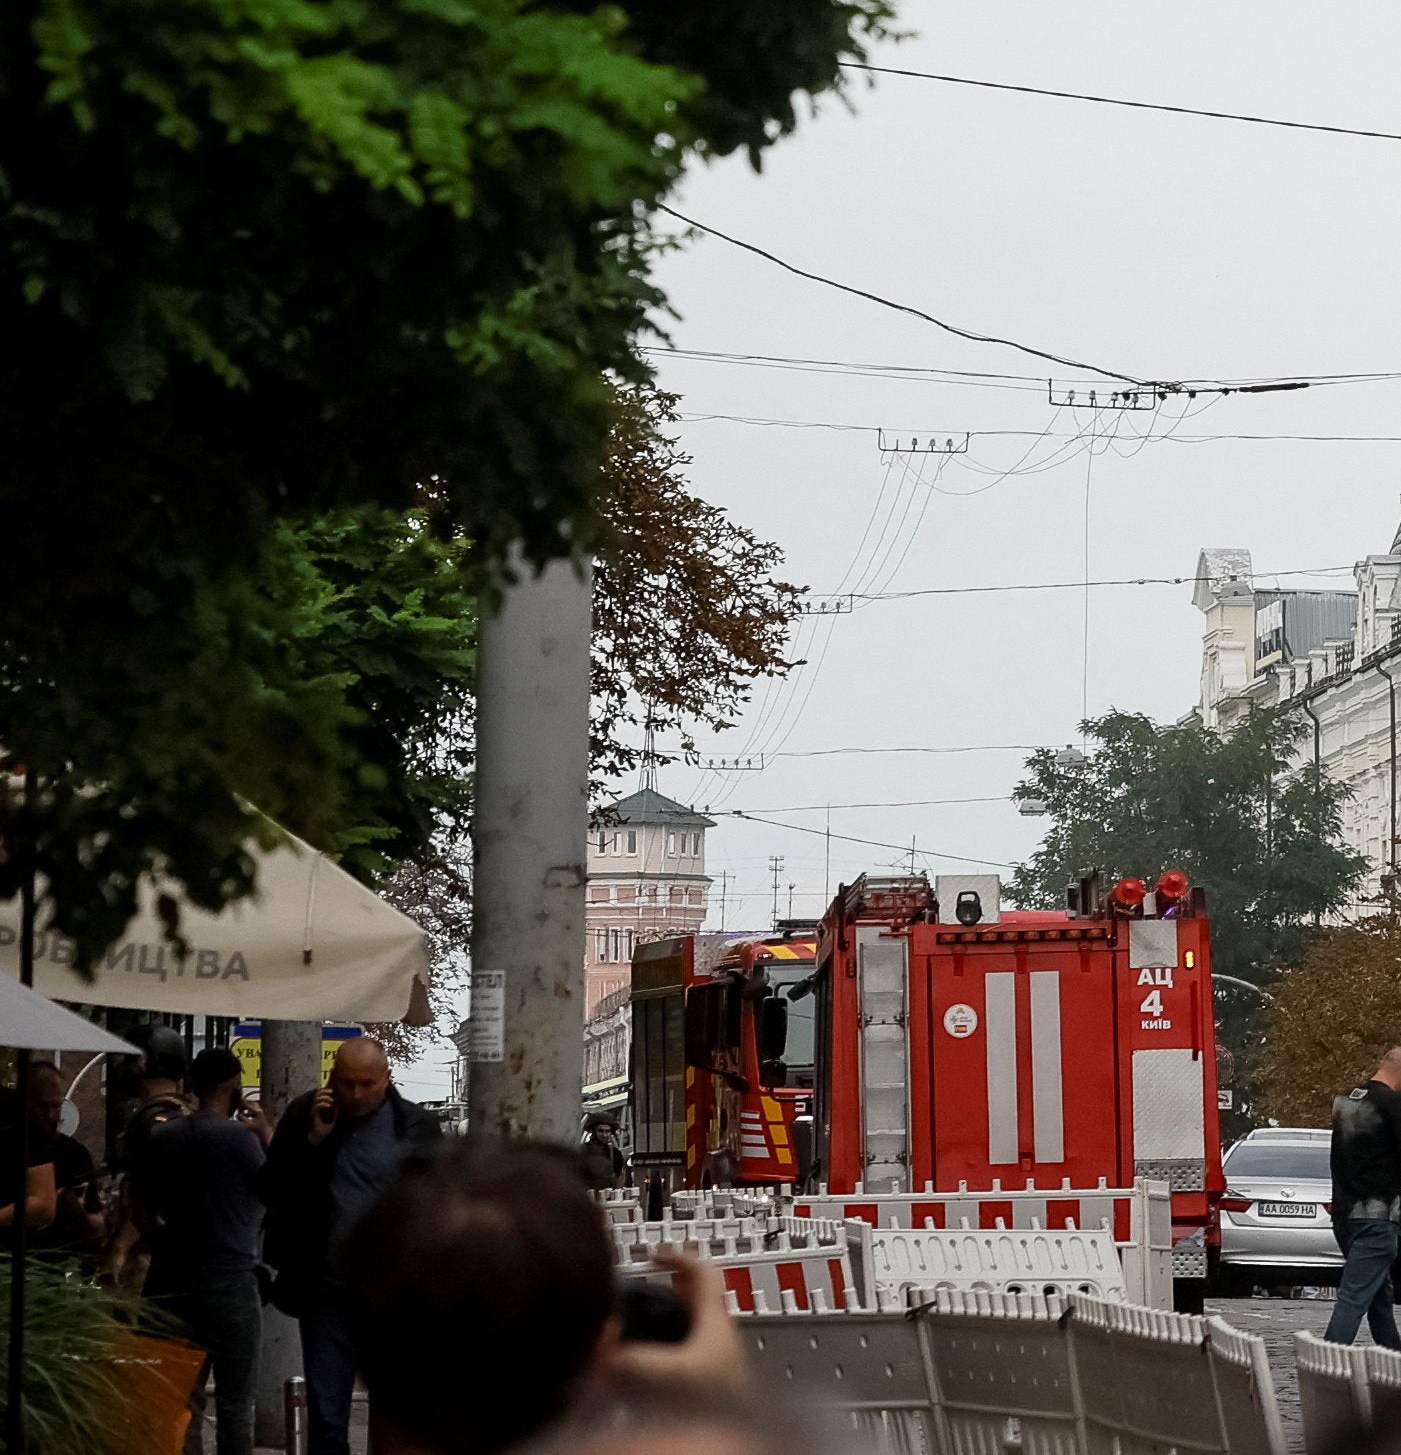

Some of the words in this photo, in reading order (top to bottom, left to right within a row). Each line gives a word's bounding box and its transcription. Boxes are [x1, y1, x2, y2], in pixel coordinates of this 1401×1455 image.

[1137, 968, 1173, 988] АЦ
[1141, 990, 1163, 1016] 4
[1142, 1019, 1171, 1029] КИЇВ
[1280, 1204, 1299, 1213] 0059
